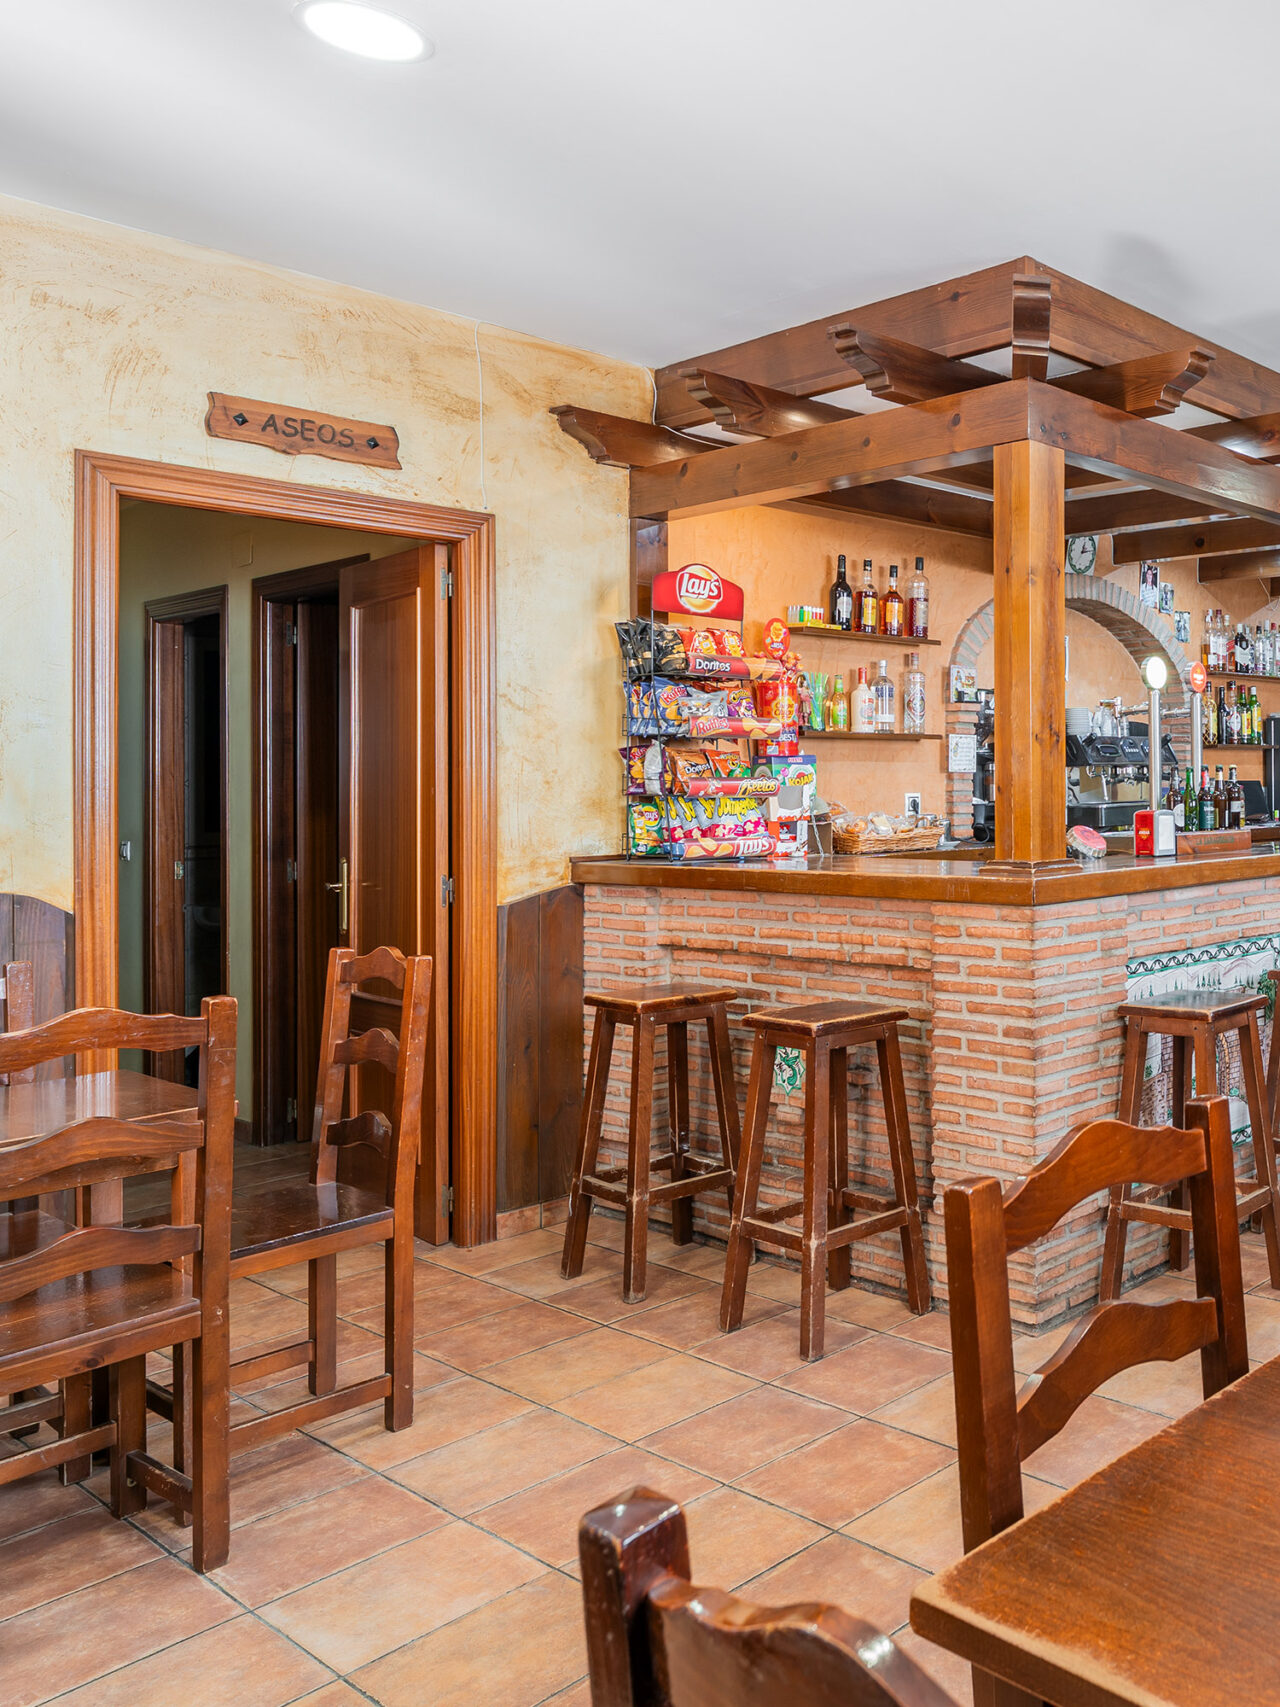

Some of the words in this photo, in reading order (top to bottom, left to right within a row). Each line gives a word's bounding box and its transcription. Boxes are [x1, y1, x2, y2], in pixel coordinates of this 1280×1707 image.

[261, 413, 355, 448] ASEOS
[680, 573, 720, 599] Lay's
[695, 658, 731, 672] Doritos
[696, 717, 729, 735] Ruffles
[788, 773, 814, 787] KOJAK
